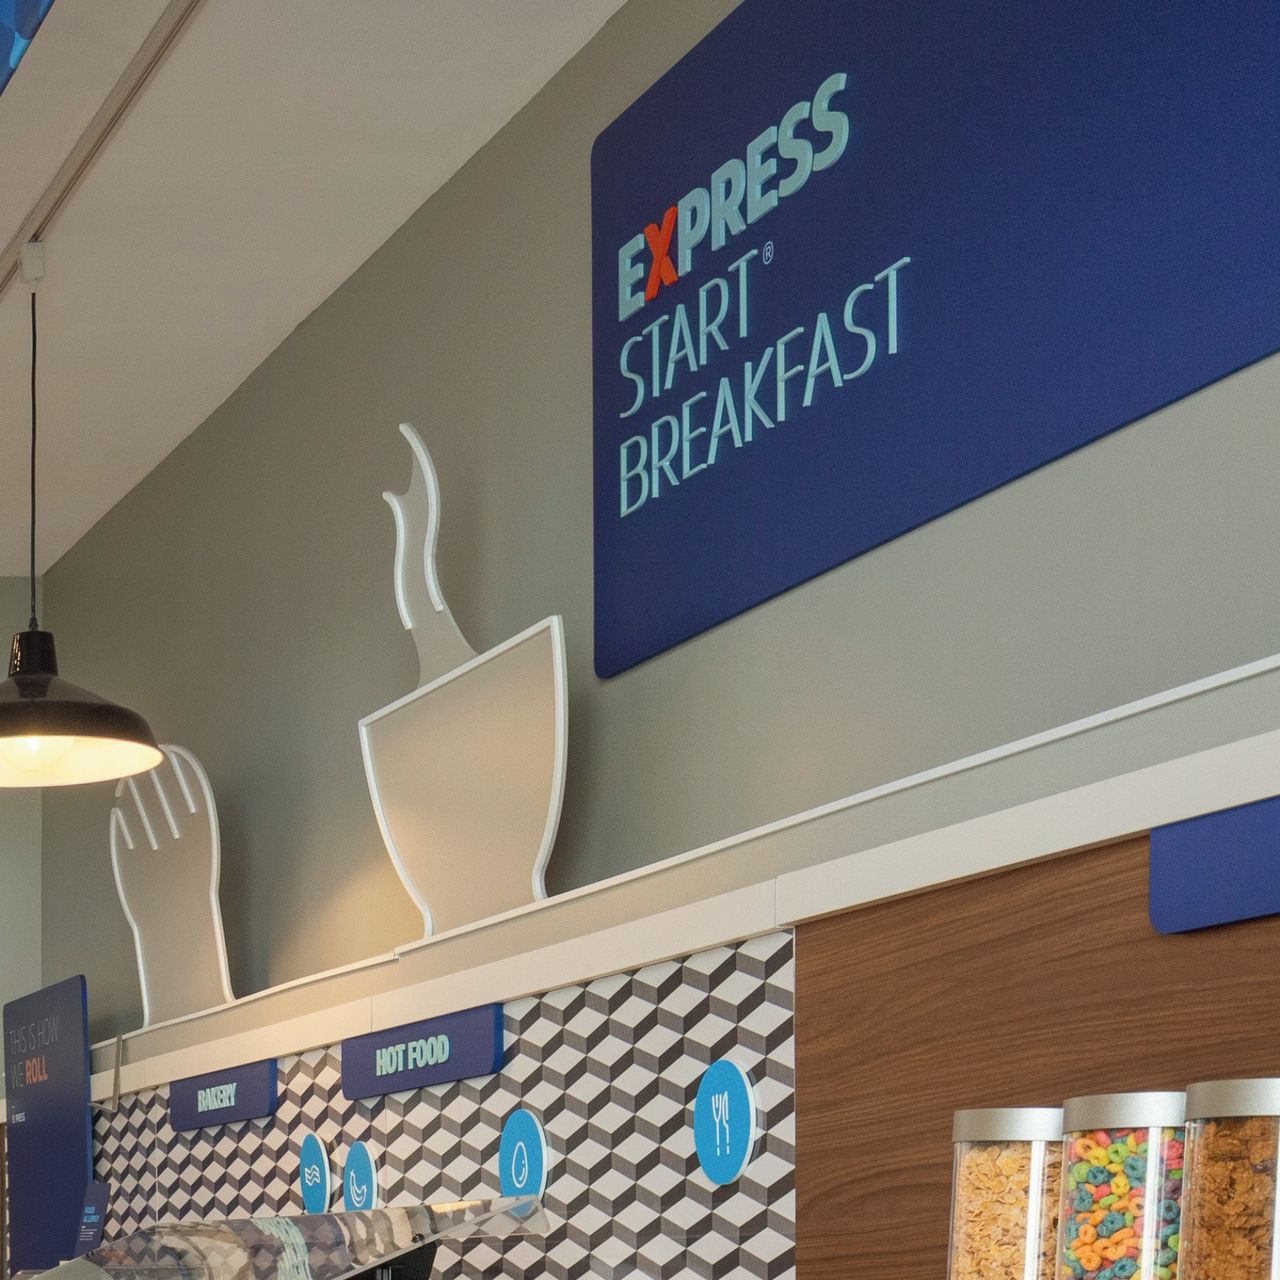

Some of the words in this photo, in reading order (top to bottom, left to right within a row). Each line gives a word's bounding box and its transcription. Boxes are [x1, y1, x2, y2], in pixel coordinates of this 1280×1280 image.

[618, 72, 850, 322] EXPRESS
[619, 256, 912, 518] BREAKFAST
[25, 1055, 49, 1085] ROLL
[374, 1042, 406, 1077] HOT
[407, 1034, 450, 1071] FOOD
[197, 1082, 238, 1114] BAKERY
